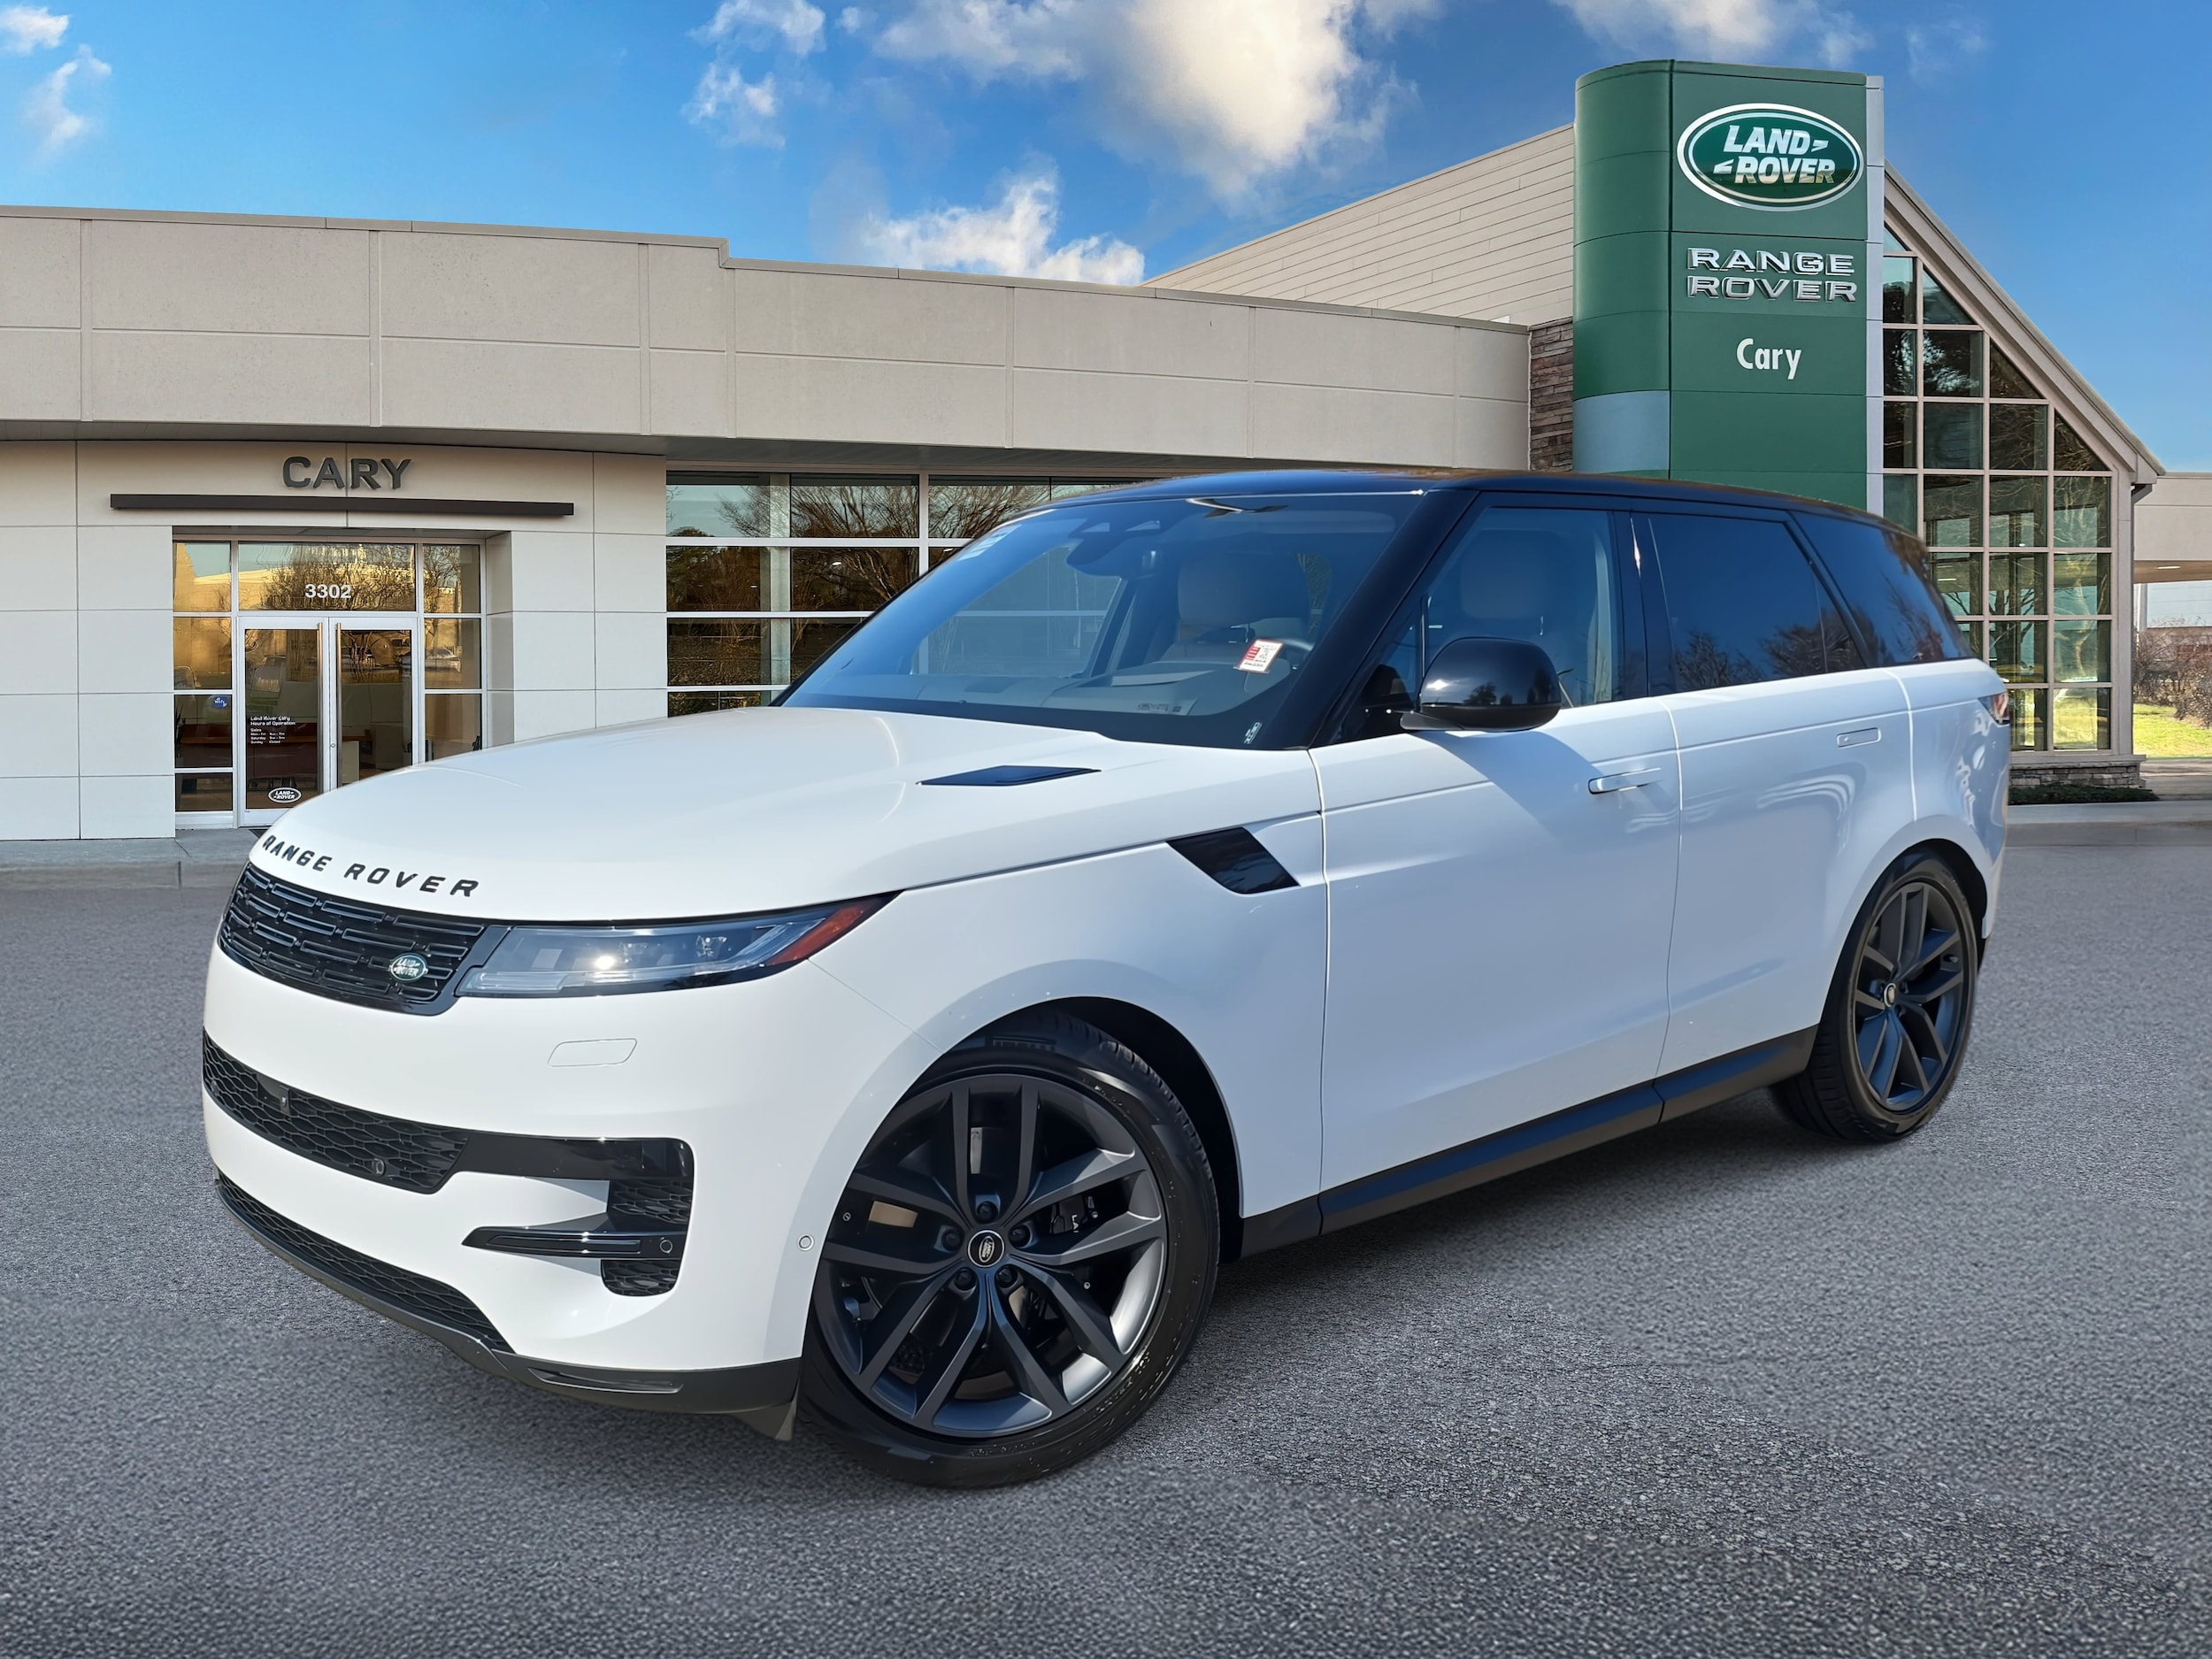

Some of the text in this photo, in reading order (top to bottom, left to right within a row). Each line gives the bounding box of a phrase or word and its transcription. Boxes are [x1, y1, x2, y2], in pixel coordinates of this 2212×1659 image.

[1724, 125, 1810, 155] LAND
[1734, 156, 1836, 184] ROVER
[1687, 248, 1855, 276] RANGE
[1687, 275, 1858, 303] ROVER
[1736, 338, 1802, 380] Cary
[283, 457, 411, 489] CARY
[305, 583, 352, 599] 3302
[263, 834, 480, 897] RANGE ROVER
